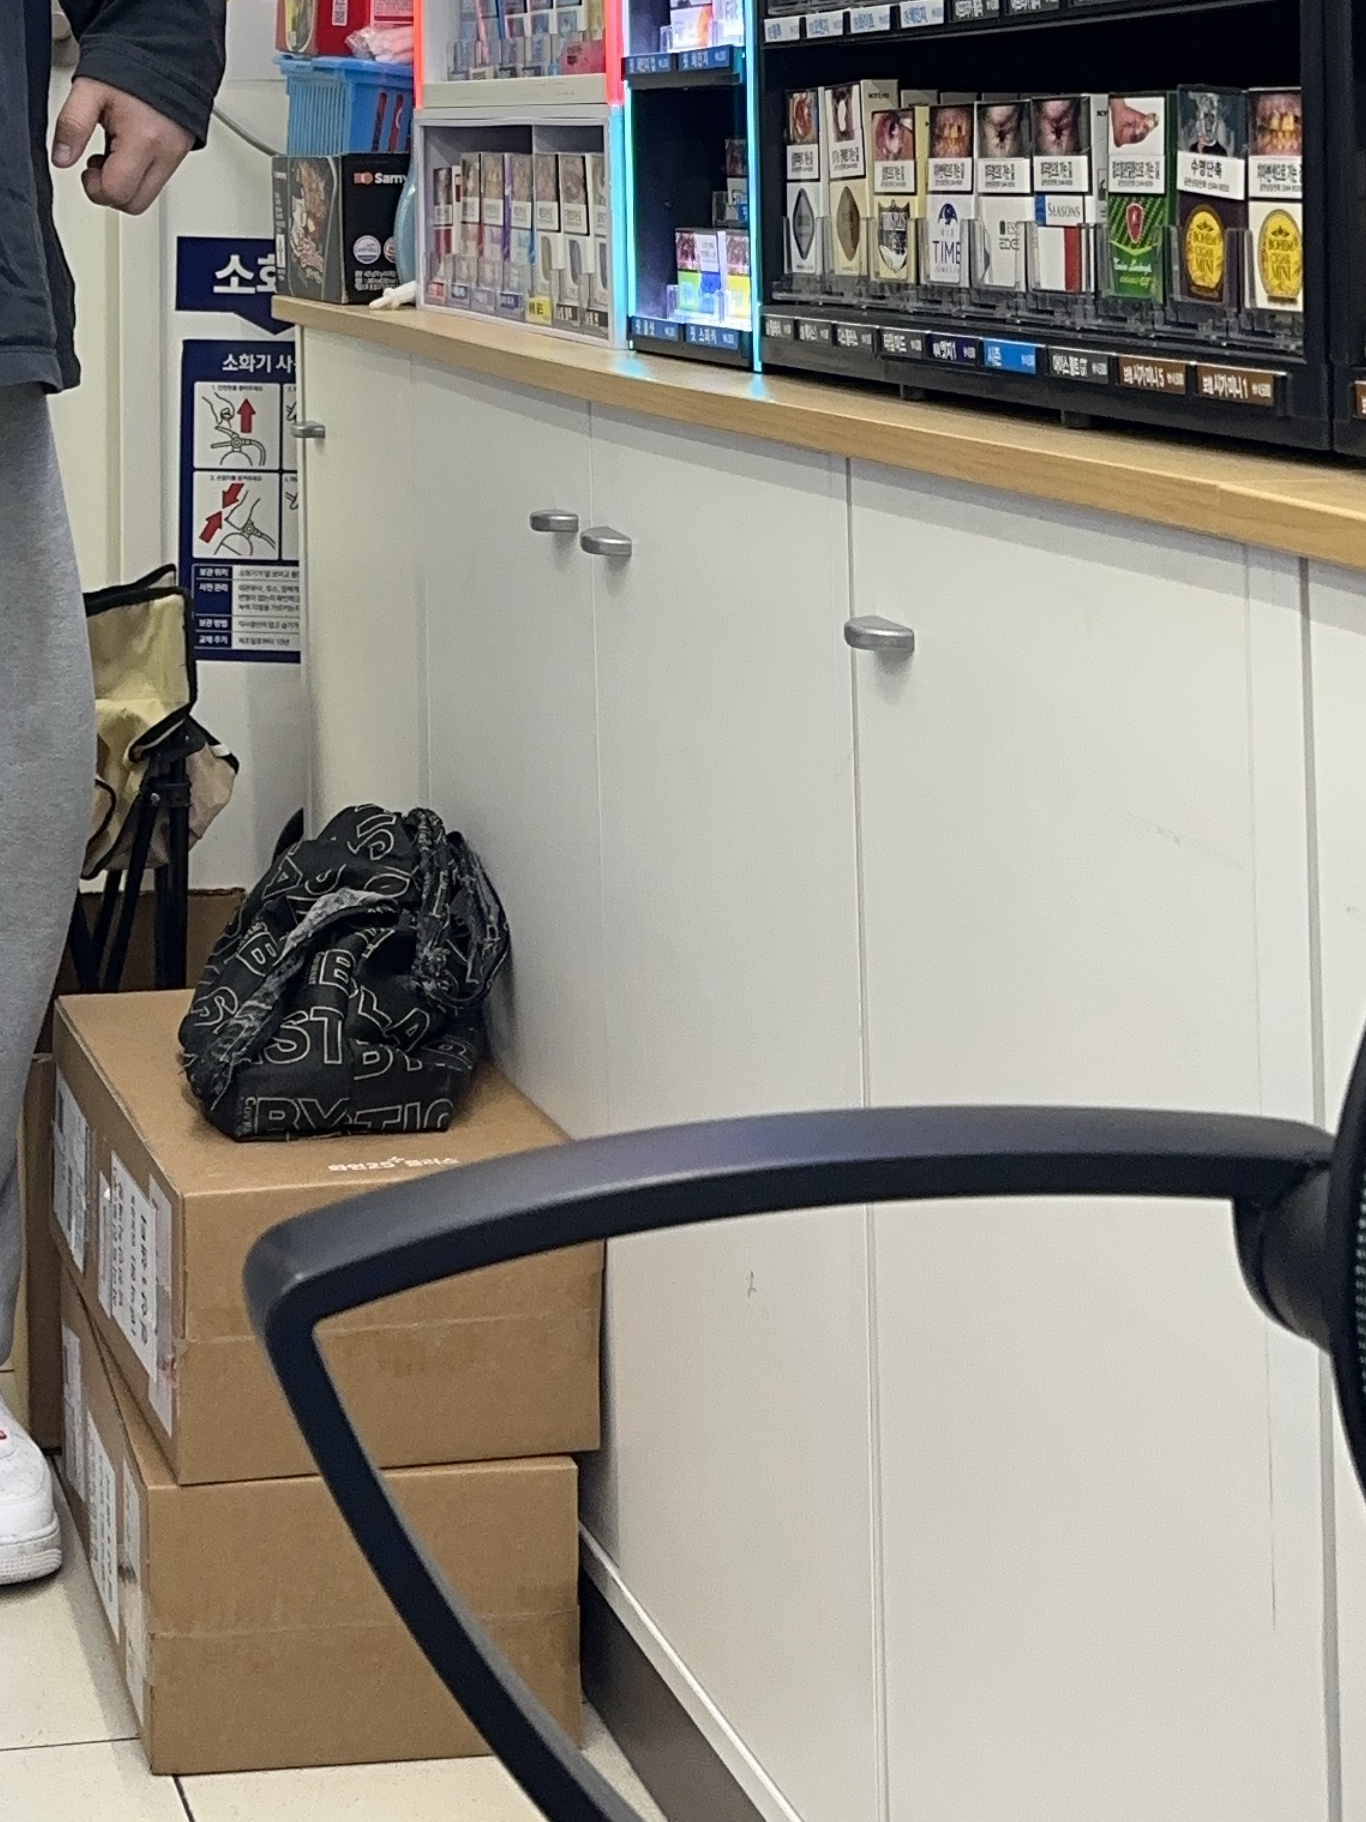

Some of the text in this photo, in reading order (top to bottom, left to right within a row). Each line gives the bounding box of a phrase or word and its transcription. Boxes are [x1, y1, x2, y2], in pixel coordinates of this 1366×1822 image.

[1191, 159, 1223, 178] 수명단축
[1047, 201, 1082, 218] SEASONS
[932, 240, 961, 265] TIME
[222, 353, 297, 374] 소화기 사
